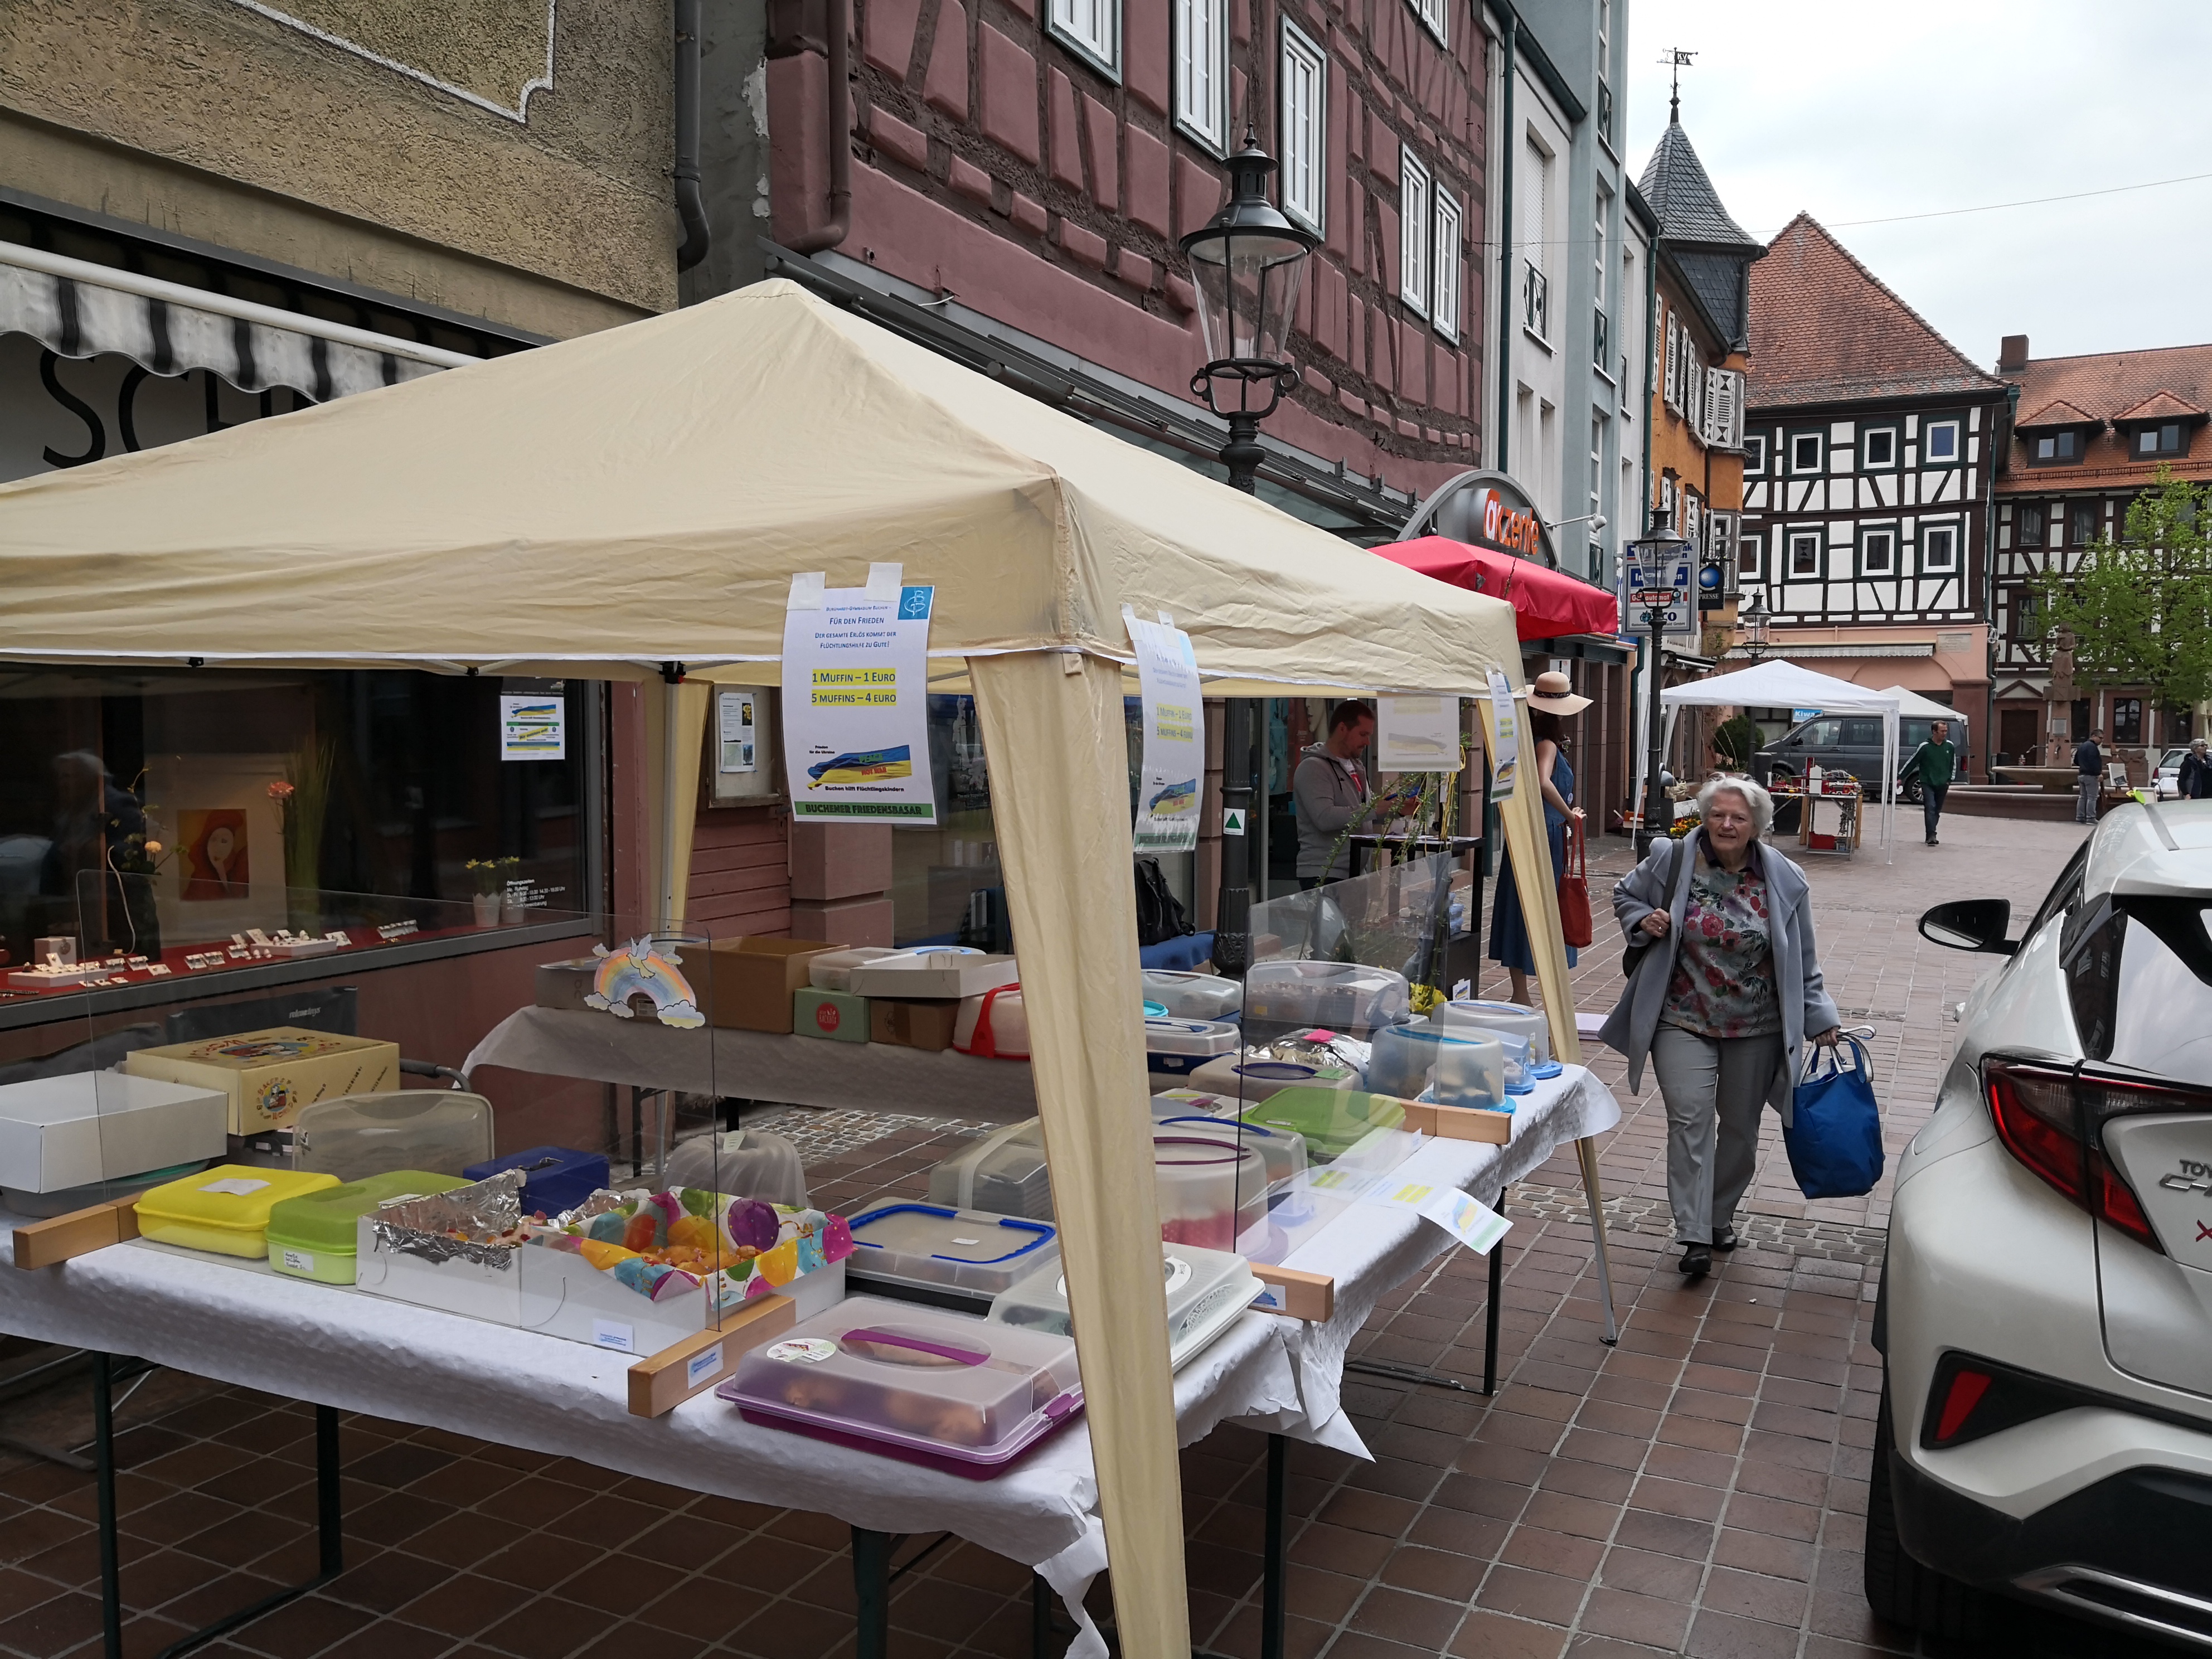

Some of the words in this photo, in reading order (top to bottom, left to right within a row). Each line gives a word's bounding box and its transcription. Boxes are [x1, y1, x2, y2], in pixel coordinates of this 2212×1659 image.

[1486, 499, 1539, 555] akzente
[813, 673, 818, 682] 1
[820, 673, 853, 682] MUFFIN
[864, 672, 869, 682] 1
[872, 672, 896, 682] EURO
[812, 693, 817, 703] 5
[819, 695, 855, 703] MUFFINS
[865, 693, 871, 702] 4
[874, 694, 896, 702] EURO
[805, 804, 851, 814] BUCHENER
[852, 805, 922, 815] FRIEDENSBASAR
